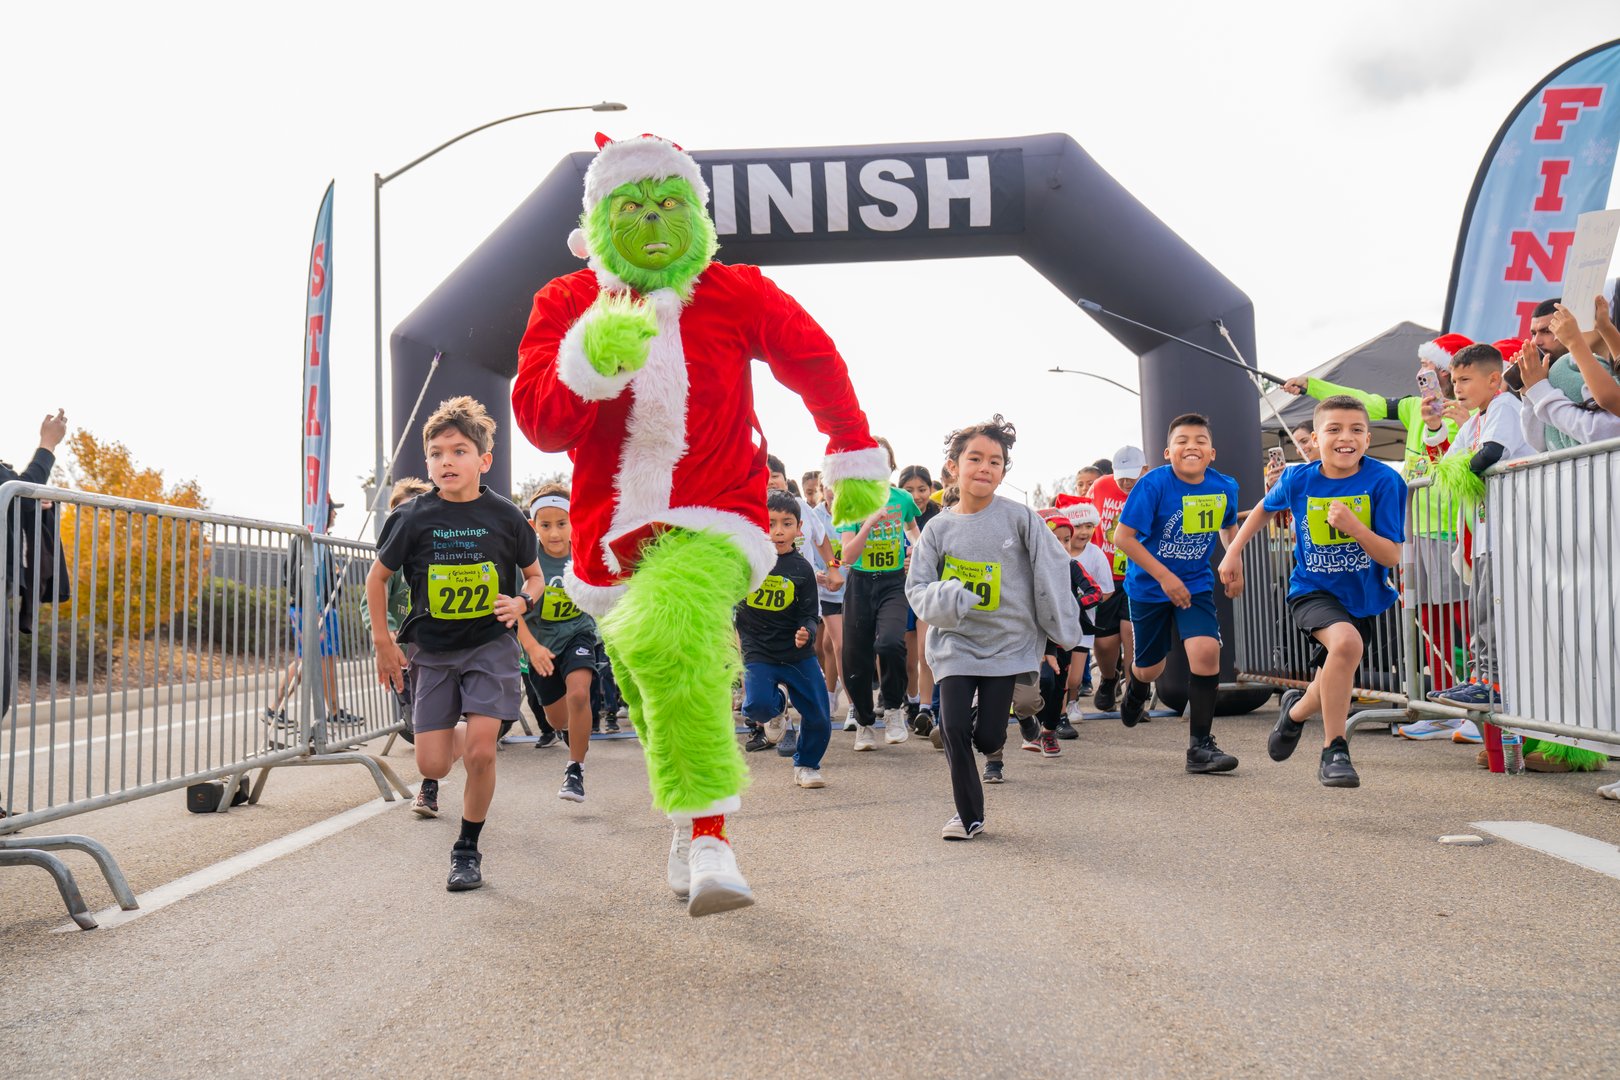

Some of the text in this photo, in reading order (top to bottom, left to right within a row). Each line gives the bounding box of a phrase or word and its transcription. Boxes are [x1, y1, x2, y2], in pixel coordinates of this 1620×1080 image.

[711, 155, 992, 235] INISH
[1197, 509, 1214, 529] 11
[432, 527, 489, 539] Nightwings.
[432, 540, 478, 549] Icewings.
[434, 551, 486, 561] Rainwings.
[867, 551, 895, 568] 165
[439, 584, 490, 614] 222
[753, 588, 786, 608] 278
